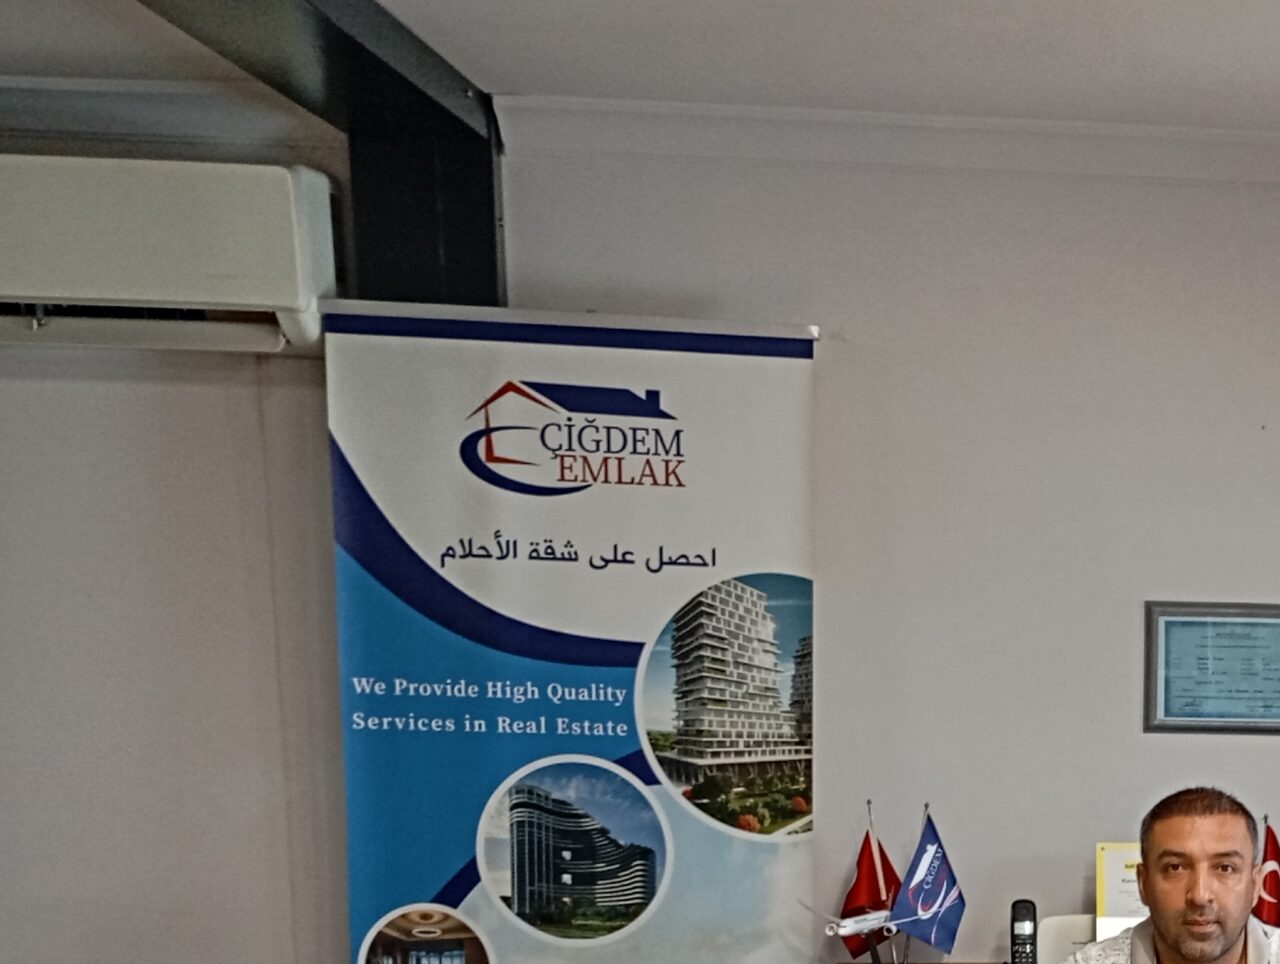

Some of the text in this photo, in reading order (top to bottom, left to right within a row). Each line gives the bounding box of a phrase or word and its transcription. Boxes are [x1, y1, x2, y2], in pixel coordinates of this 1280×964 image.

[539, 416, 685, 459] ÇİĞDEM
[556, 454, 687, 488] EMLAK
[440, 529, 716, 574] احصل على شقة الأحلام
[352, 677, 627, 707] We Provide High Quality
[352, 712, 628, 737] Services in Real Estate
